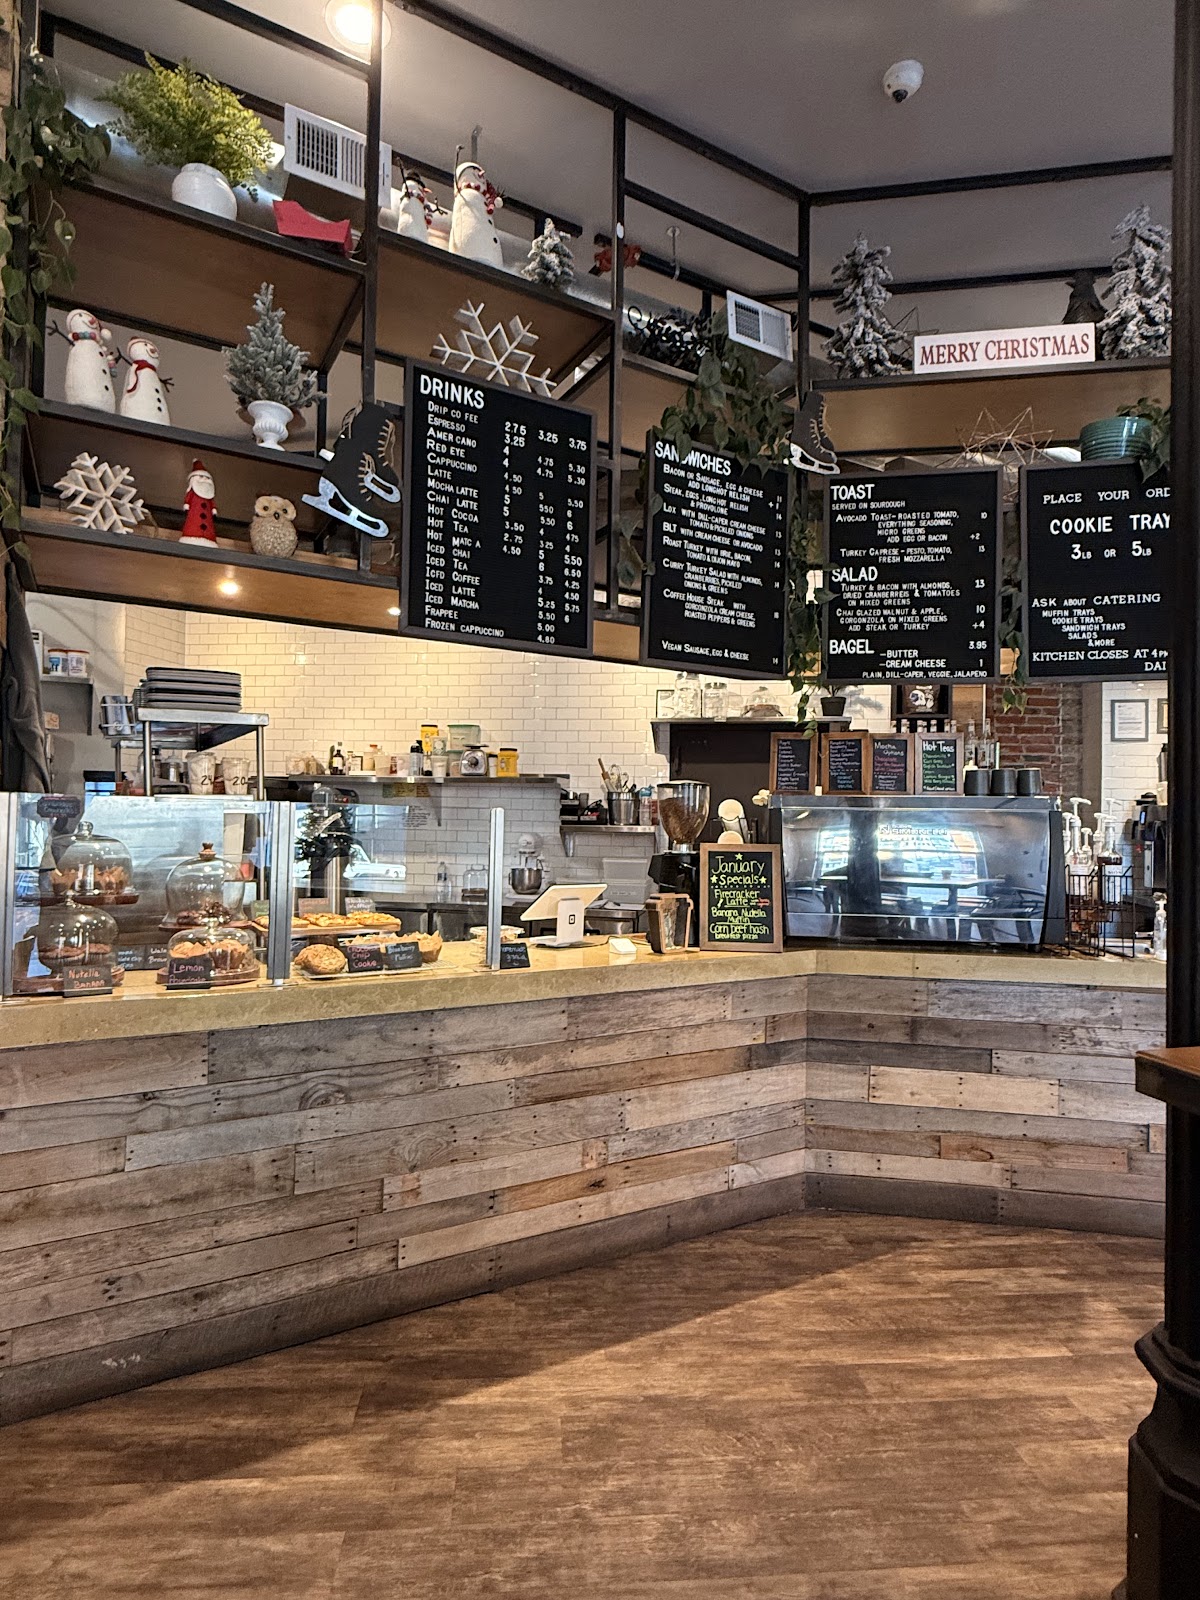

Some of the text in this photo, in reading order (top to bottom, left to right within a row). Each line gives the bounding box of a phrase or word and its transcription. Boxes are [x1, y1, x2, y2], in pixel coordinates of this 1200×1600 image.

[919, 333, 1090, 366] MERRY CHRISTMAS
[420, 374, 485, 410] DRINKS
[428, 401, 448, 415] DRIP
[428, 414, 466, 432] ESPRESSO
[504, 434, 525, 447] 3.25
[505, 421, 587, 451] 2.75 3.25 3.75
[426, 439, 466, 458] RED EYE
[427, 452, 477, 473] CAPPUCCINO
[655, 441, 732, 476] SANWICHES
[428, 465, 452, 480] LATTE
[536, 467, 553, 478] 4.75
[663, 464, 686, 478] BACON
[427, 478, 454, 493] MOCHA
[456, 487, 478, 498] LATTE
[830, 484, 875, 500] TOAST
[427, 491, 478, 510] CHAI LATTE
[1043, 493, 1082, 504] PLACE
[1098, 490, 1130, 501] YOUR
[428, 503, 479, 523] HOT COCOA
[663, 502, 696, 518] LOX WITH
[832, 501, 906, 510] SERVED ON SOURDOUGH
[427, 516, 525, 533] HOT TEA 3.50
[836, 514, 867, 523] AVOCADO
[1050, 513, 1171, 535] COOKIE TRAY
[427, 528, 523, 544] HOT 2.75
[663, 522, 694, 537] BLT WITH
[427, 541, 521, 559] ICED CHAI 4.50
[683, 540, 703, 552] TURKEY
[840, 548, 867, 557] TURKEY
[1071, 541, 1152, 560] 3LB OR 5LB
[426, 553, 445, 567] ICED
[453, 558, 468, 571] TEA
[878, 554, 945, 563] FRESH MOZZARELLA
[663, 558, 727, 579] CURRY TURKEY SALAD
[831, 566, 878, 582] SALAD
[452, 571, 480, 585] COFFEE
[564, 568, 581, 578] 6.50
[425, 579, 444, 592] ICED
[452, 585, 476, 597] LATTE
[565, 580, 580, 590] 4.25
[841, 583, 867, 592] TURKEY
[868, 583, 875, 591] &
[876, 583, 899, 591] BACON
[975, 579, 985, 589] 13
[425, 592, 480, 609] ICED MATCHA
[663, 588, 746, 611] COFFEE HOUSE STEAK WITH
[843, 589, 960, 600] DRIED & TOMATOES
[1032, 593, 1161, 608] ASK ABOUT CATERING
[425, 597, 580, 619] FRAPPEE 5.25 5.75
[848, 598, 986, 614] ON MIXED GREENS 10
[1042, 608, 1095, 618] MUFFIN TRAYS
[425, 611, 556, 637] FROZEN CAPPUCCINO 5.50
[865, 620, 985, 631] STEAK OR TURKEY +4
[1052, 616, 1104, 625] COOKIE TRAYS
[1061, 623, 1126, 633] SANDWICH TRAYS
[1068, 631, 1098, 640] SALADS
[662, 640, 682, 652] VEGAN
[829, 639, 875, 654] BAGEL
[1032, 651, 1085, 662] KITCHEN
[1087, 650, 1129, 660] CLOSES
[1133, 649, 1149, 659] AT
[915, 659, 947, 668] CHEESE
[922, 741, 955, 753] Hot Teas
[200, 774, 213, 786] 24
[232, 776, 247, 786] 20
[711, 856, 765, 876] January
[719, 874, 760, 886] Specials
[714, 889, 760, 899] Firecracker
[726, 898, 749, 906] Latte
[711, 906, 739, 918] Banana
[710, 923, 770, 935] Corn beef hash
[173, 963, 205, 974] Lemon
[353, 960, 377, 968] Cookie
[68, 969, 100, 979] Nutella
